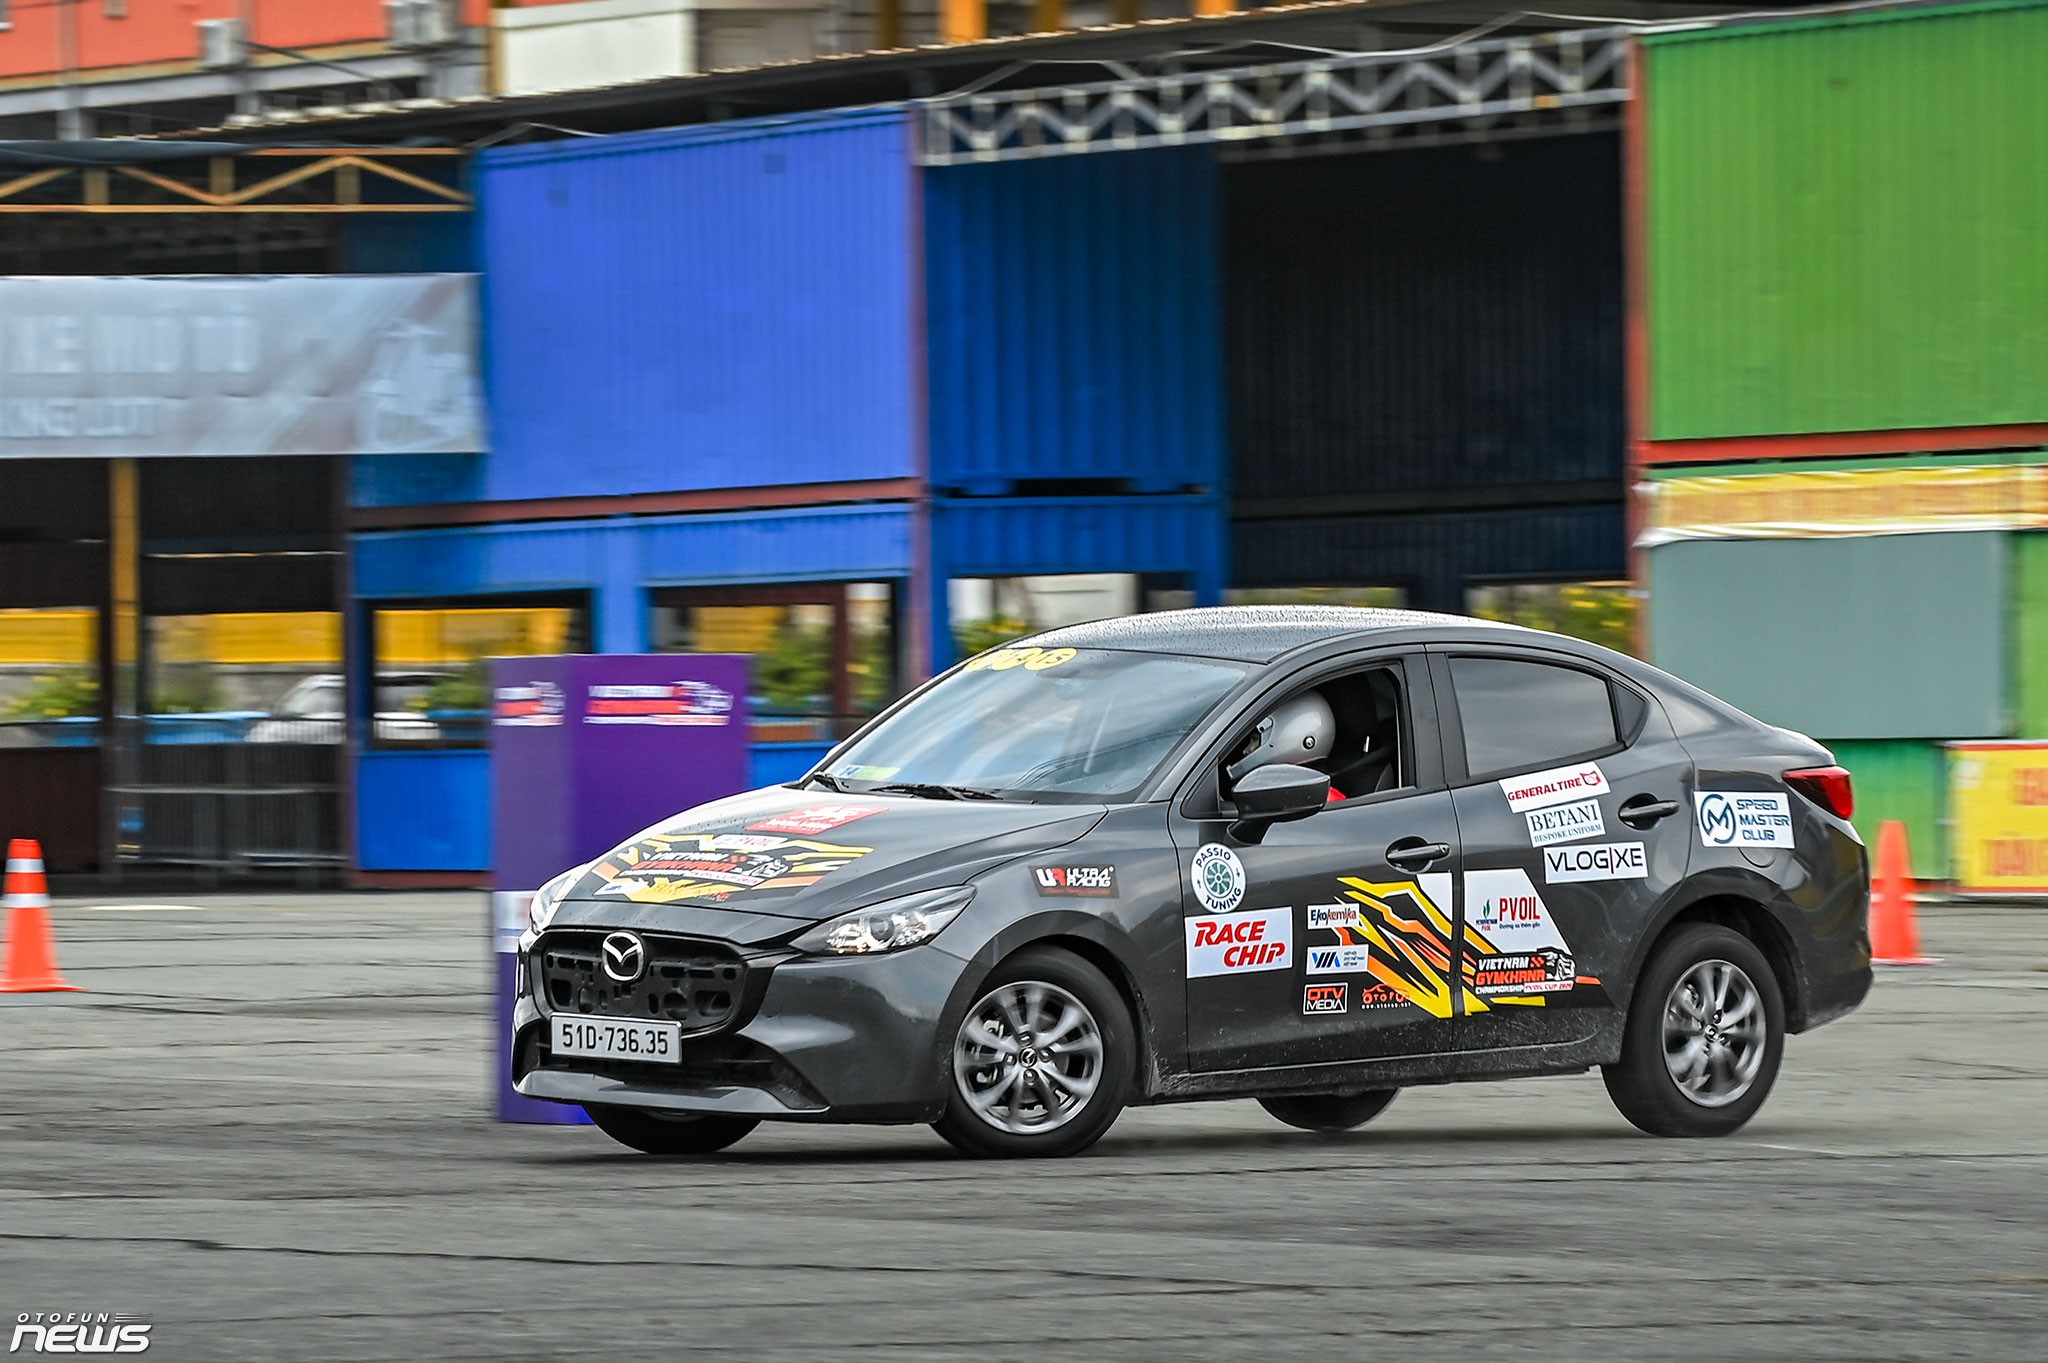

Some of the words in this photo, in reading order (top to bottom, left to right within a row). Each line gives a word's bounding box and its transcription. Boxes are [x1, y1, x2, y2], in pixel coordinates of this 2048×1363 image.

[1507, 783, 1557, 801] GENERAL
[1557, 777, 1582, 791] TIRE
[1736, 799, 1778, 811] SPEED
[1529, 804, 1599, 832] BETANI
[1739, 814, 1790, 826] MASTER
[1534, 830, 1568, 843] BESPOKE
[1567, 824, 1601, 837] UNIFORM
[1742, 829, 1776, 841] CLUB
[1195, 847, 1231, 868] PASSIO
[1066, 867, 1110, 879] ULTRA
[1205, 887, 1242, 911] TUNING
[1499, 896, 1541, 922] PVOIL
[1194, 920, 1267, 947] RACE
[1223, 942, 1286, 967] CHIP
[1478, 956, 1529, 971] VIETNAM
[1476, 969, 1546, 985] GYMKHANA
[1544, 982, 1558, 990] CUP
[1306, 999, 1346, 1011] MEDIA
